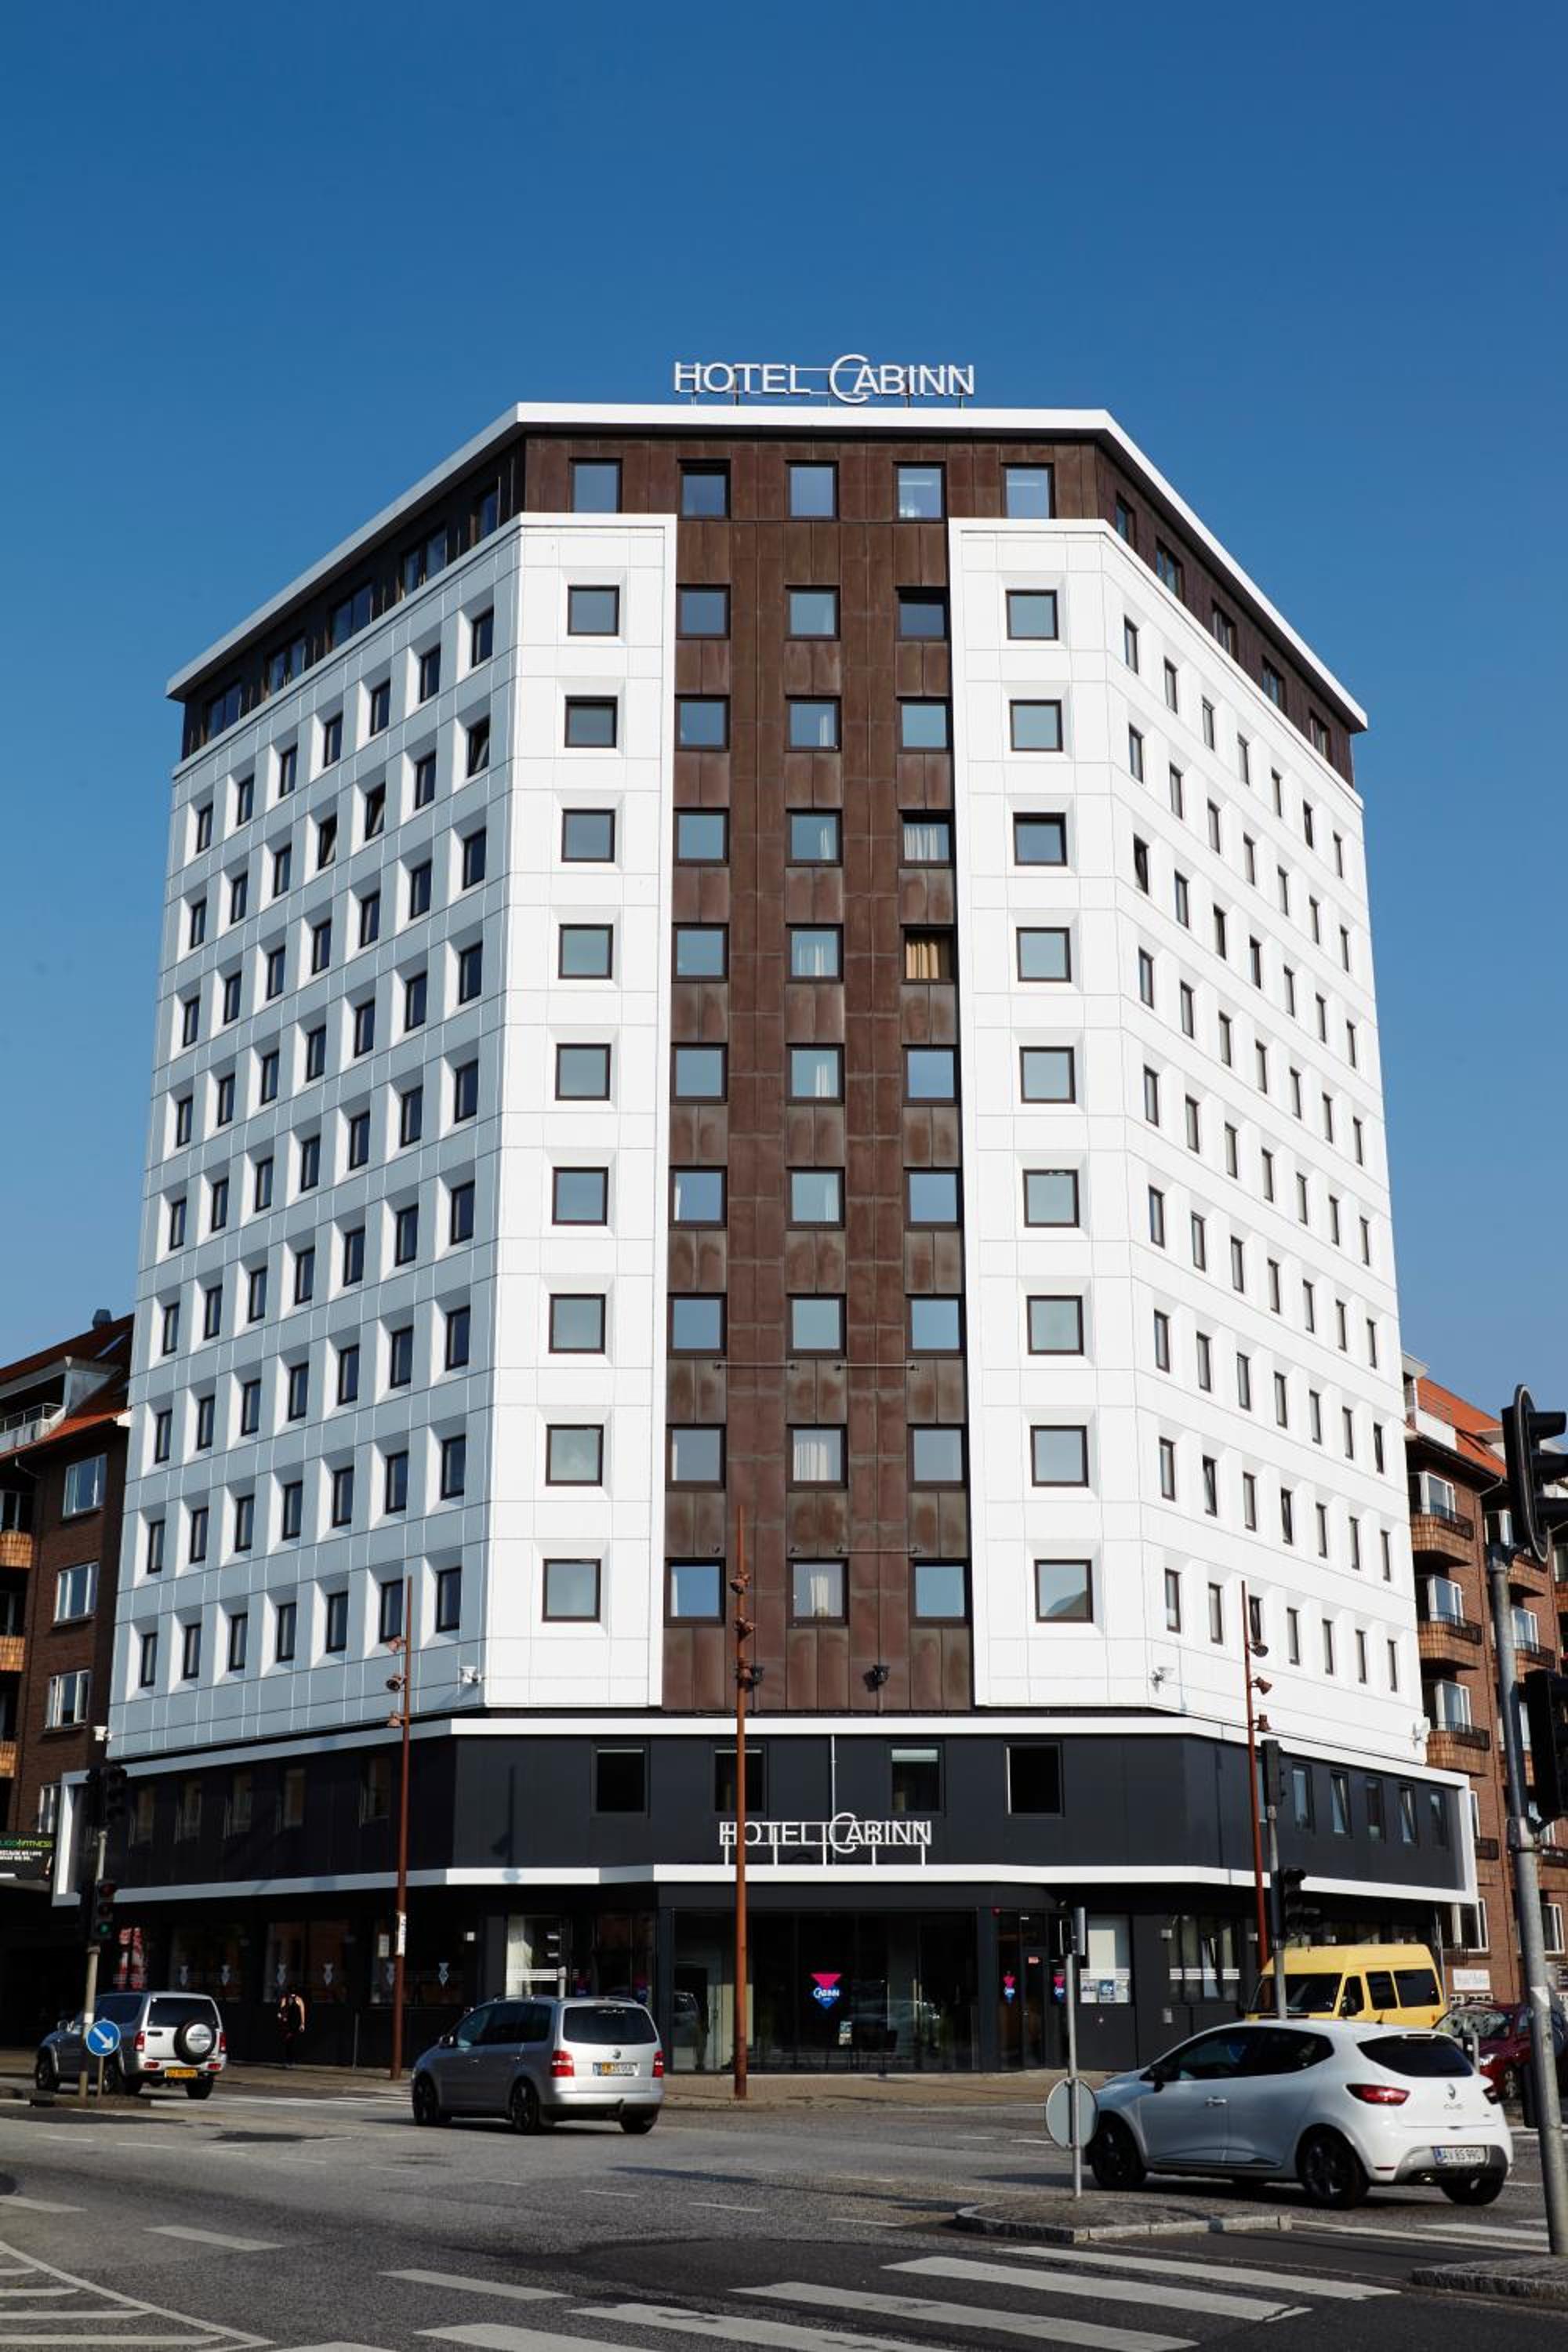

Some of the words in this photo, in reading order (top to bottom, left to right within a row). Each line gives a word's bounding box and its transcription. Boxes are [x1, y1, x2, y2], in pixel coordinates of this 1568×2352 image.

[674, 361, 811, 393] HOTEL
[829, 354, 975, 404] CABINN
[719, 1820, 817, 1846] HOTEL
[828, 1812, 932, 1853] CABINN
